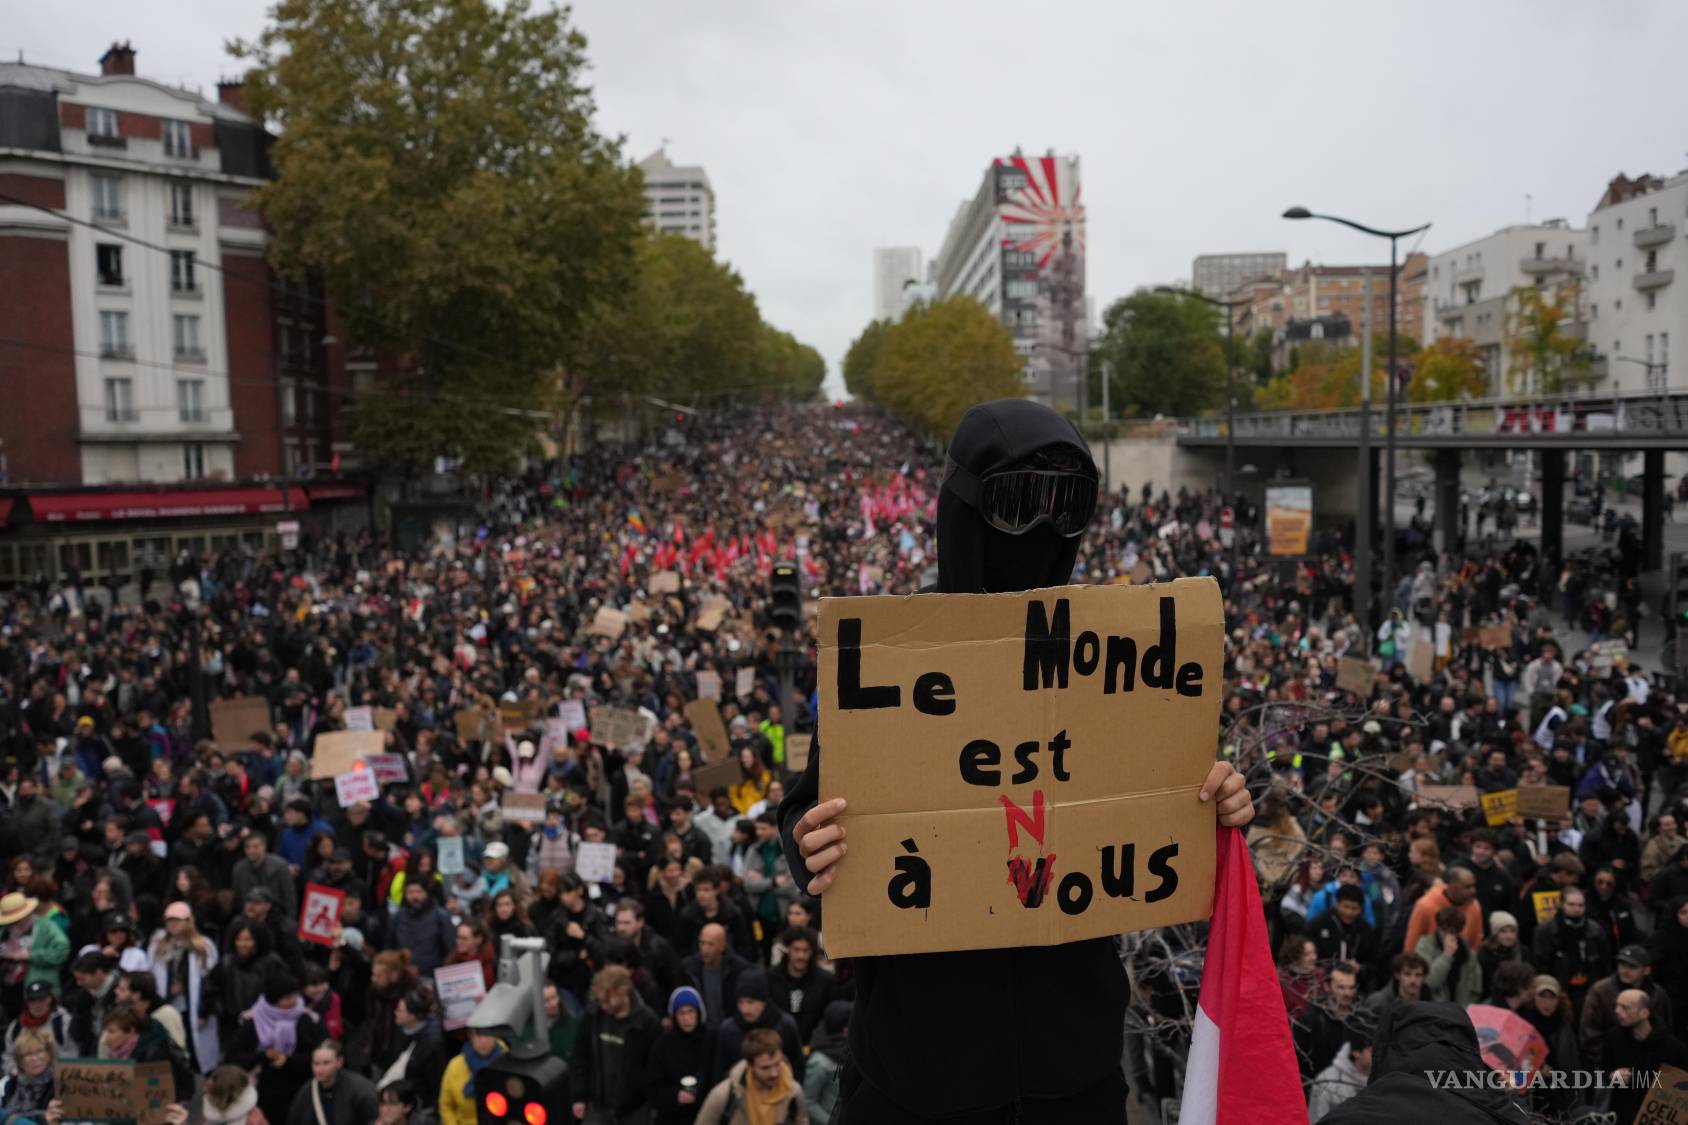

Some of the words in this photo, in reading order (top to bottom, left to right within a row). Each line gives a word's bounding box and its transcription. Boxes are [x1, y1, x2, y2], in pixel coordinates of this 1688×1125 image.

[838, 618, 956, 716] Le
[1023, 597, 1204, 697] Monde
[959, 729, 1072, 787] est
[887, 838, 932, 909] à
